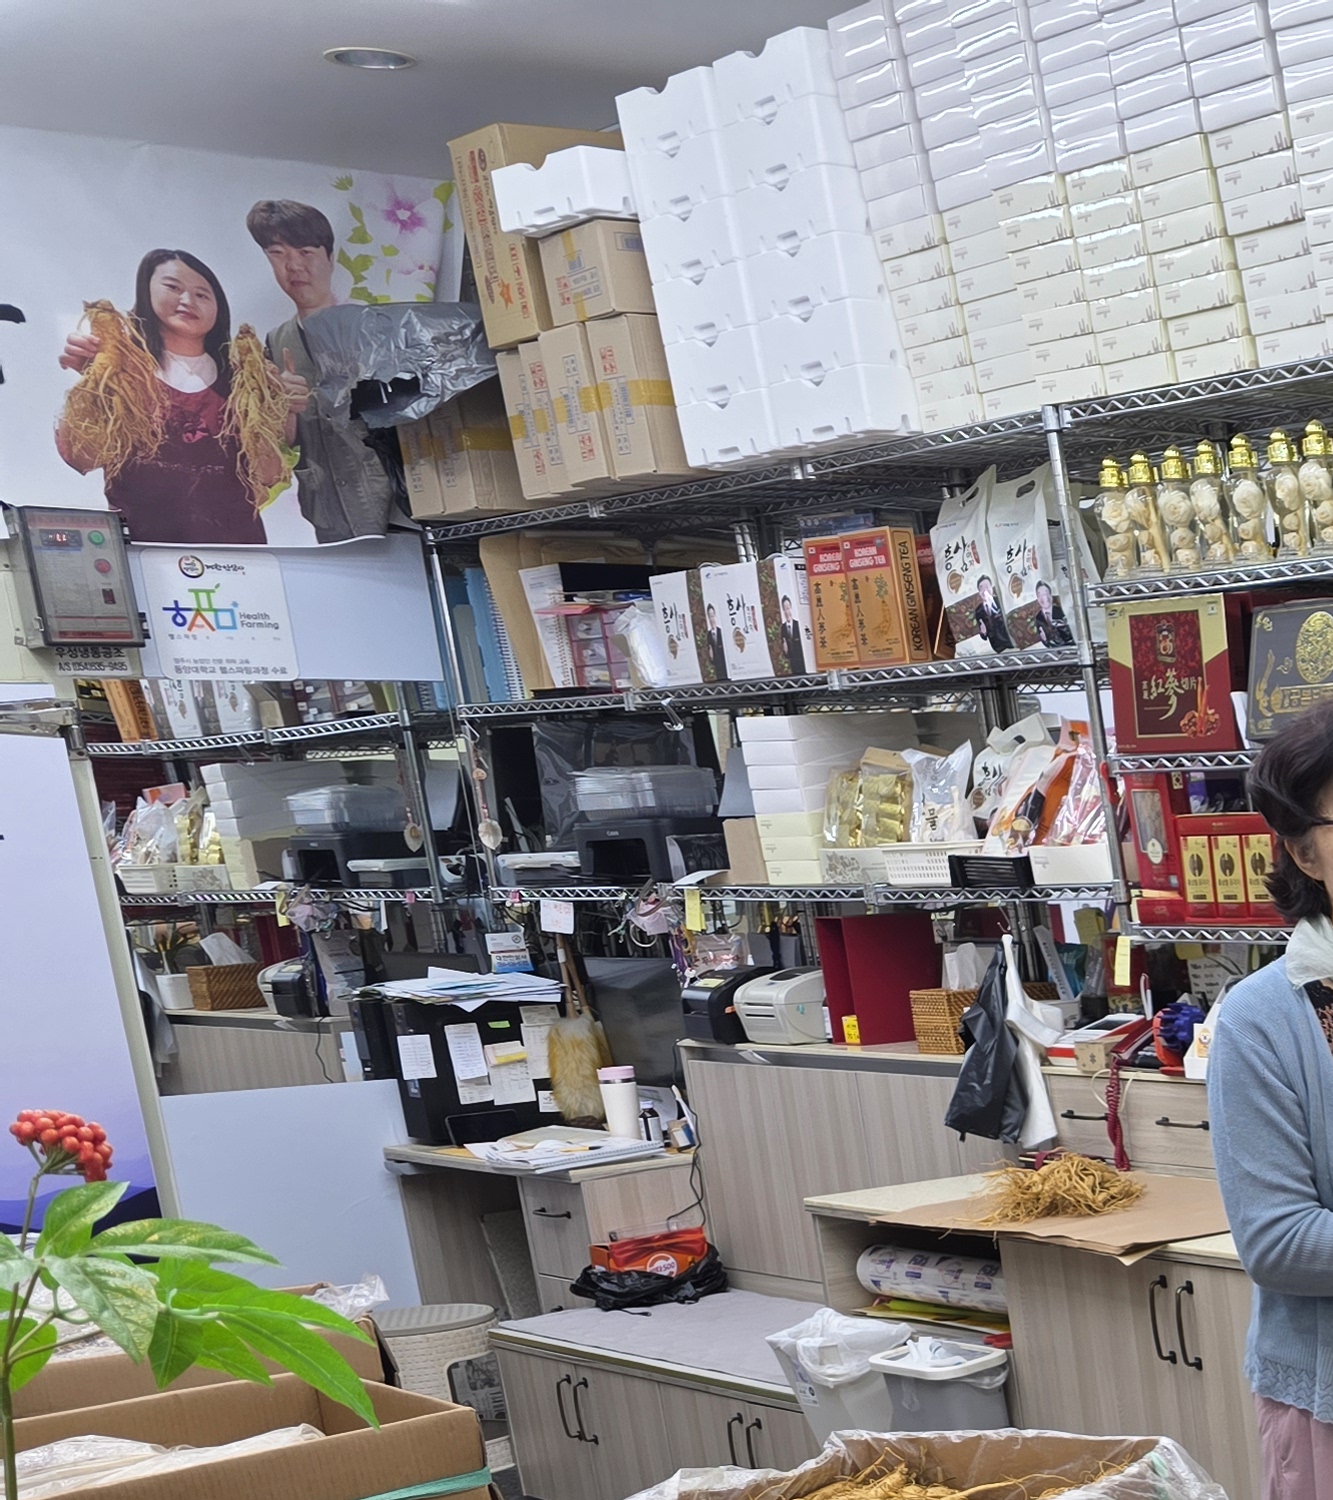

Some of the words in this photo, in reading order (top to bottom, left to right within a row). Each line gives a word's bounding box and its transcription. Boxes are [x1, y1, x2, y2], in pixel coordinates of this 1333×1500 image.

[898, 541, 910, 560] TEA
[849, 557, 874, 568] GINSENG
[875, 555, 886, 564] TEA
[902, 562, 917, 606] GINSENG
[239, 612, 270, 621] Health
[241, 620, 279, 630] Farming
[908, 607, 921, 651] KOREAN
